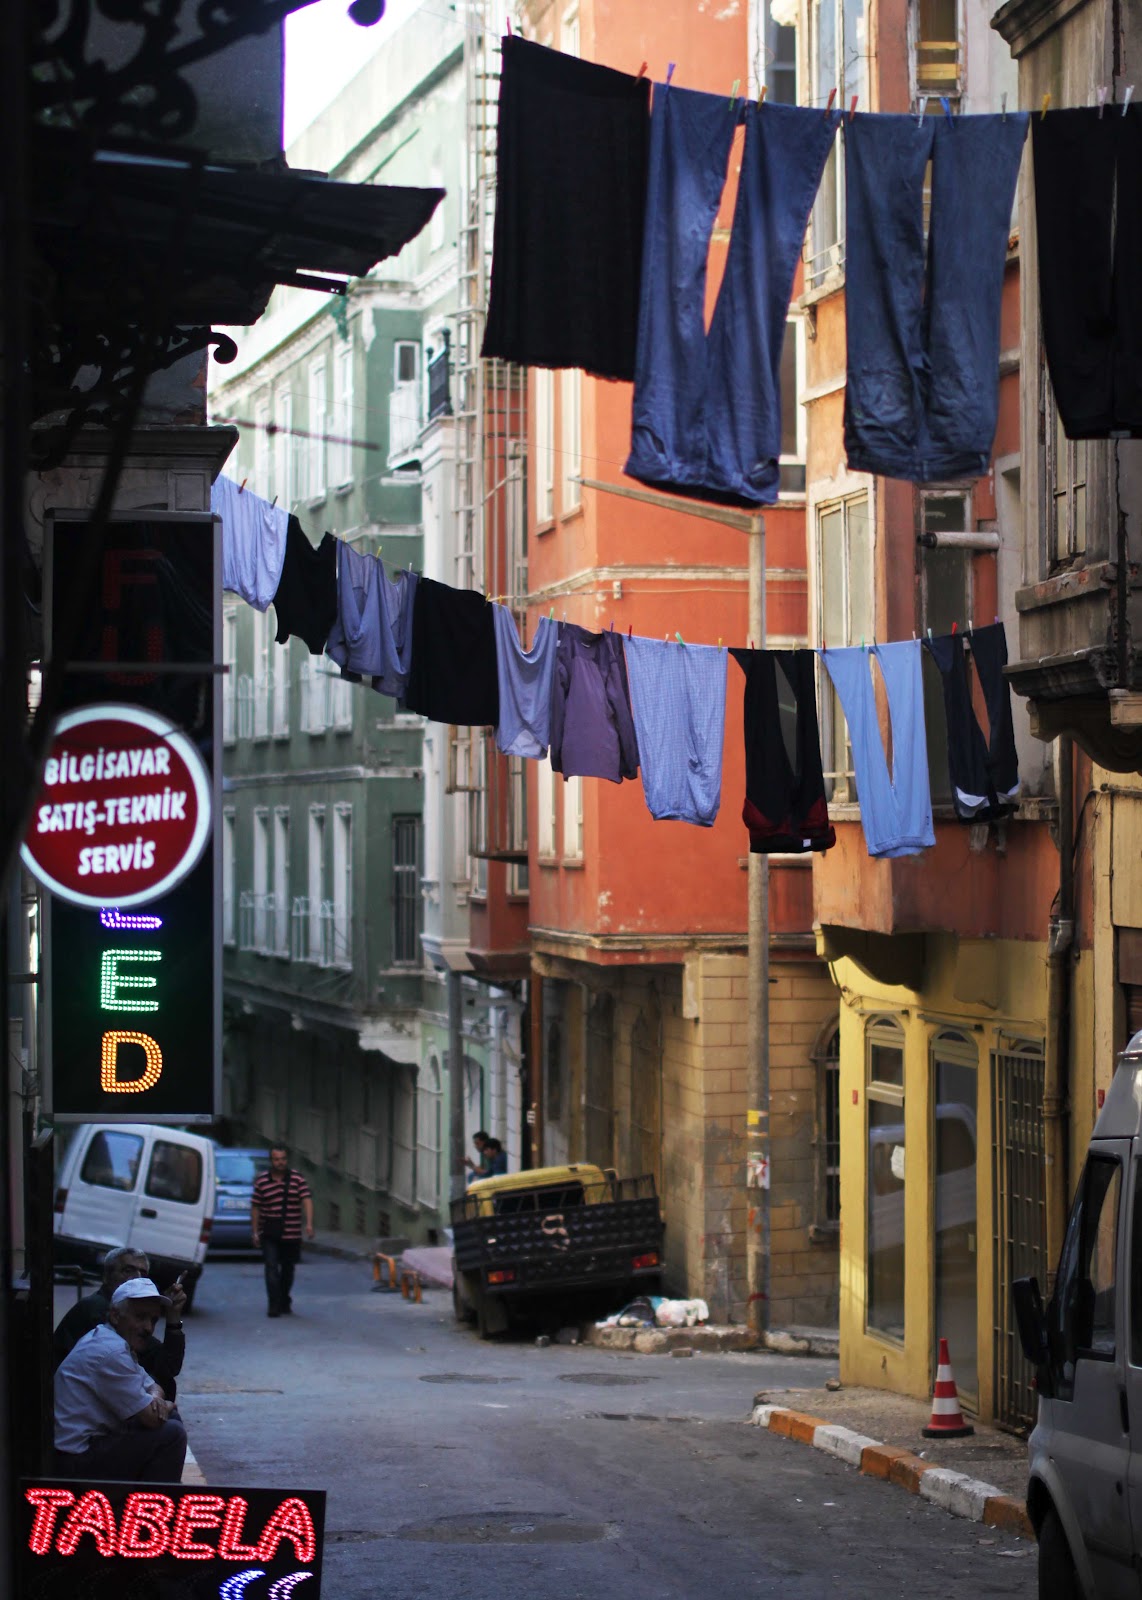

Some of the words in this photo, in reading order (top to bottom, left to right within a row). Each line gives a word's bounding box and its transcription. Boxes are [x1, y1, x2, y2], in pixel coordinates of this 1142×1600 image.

[44, 747, 170, 786] BİLGİSAYAR
[37, 787, 187, 835] SATIŞ-TEKNİK
[78, 836, 156, 876] SERVİS
[25, 1488, 316, 1563] TABELA
